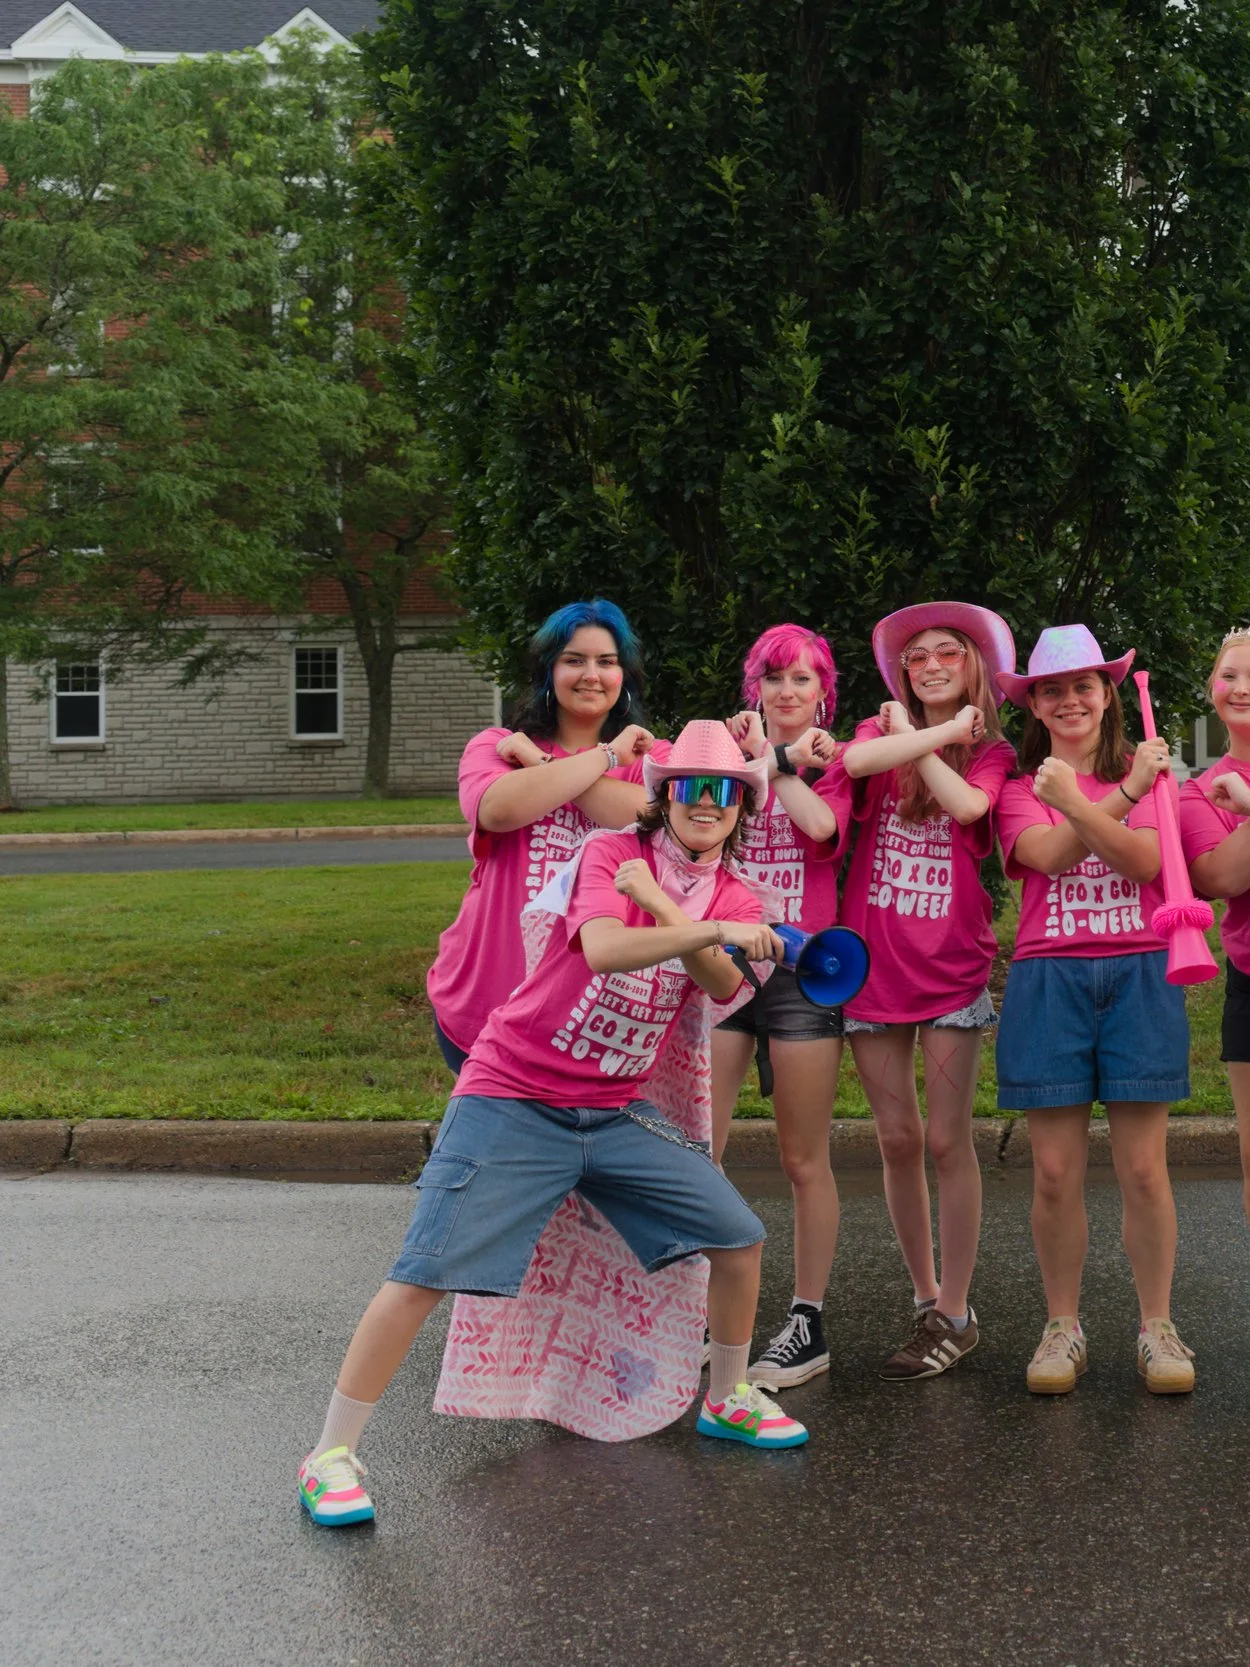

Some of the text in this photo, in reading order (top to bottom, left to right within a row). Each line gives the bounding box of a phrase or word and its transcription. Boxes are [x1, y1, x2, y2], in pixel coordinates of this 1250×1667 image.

[908, 863, 920, 883] X
[926, 866, 952, 888] GO
[1065, 878, 1138, 904] GO X GO!
[1062, 905, 1145, 937] O-WEEK
[598, 991, 631, 1014] LET'S
[630, 1004, 653, 1021] GET
[589, 1013, 618, 1039] GO
[621, 1026, 640, 1047] X
